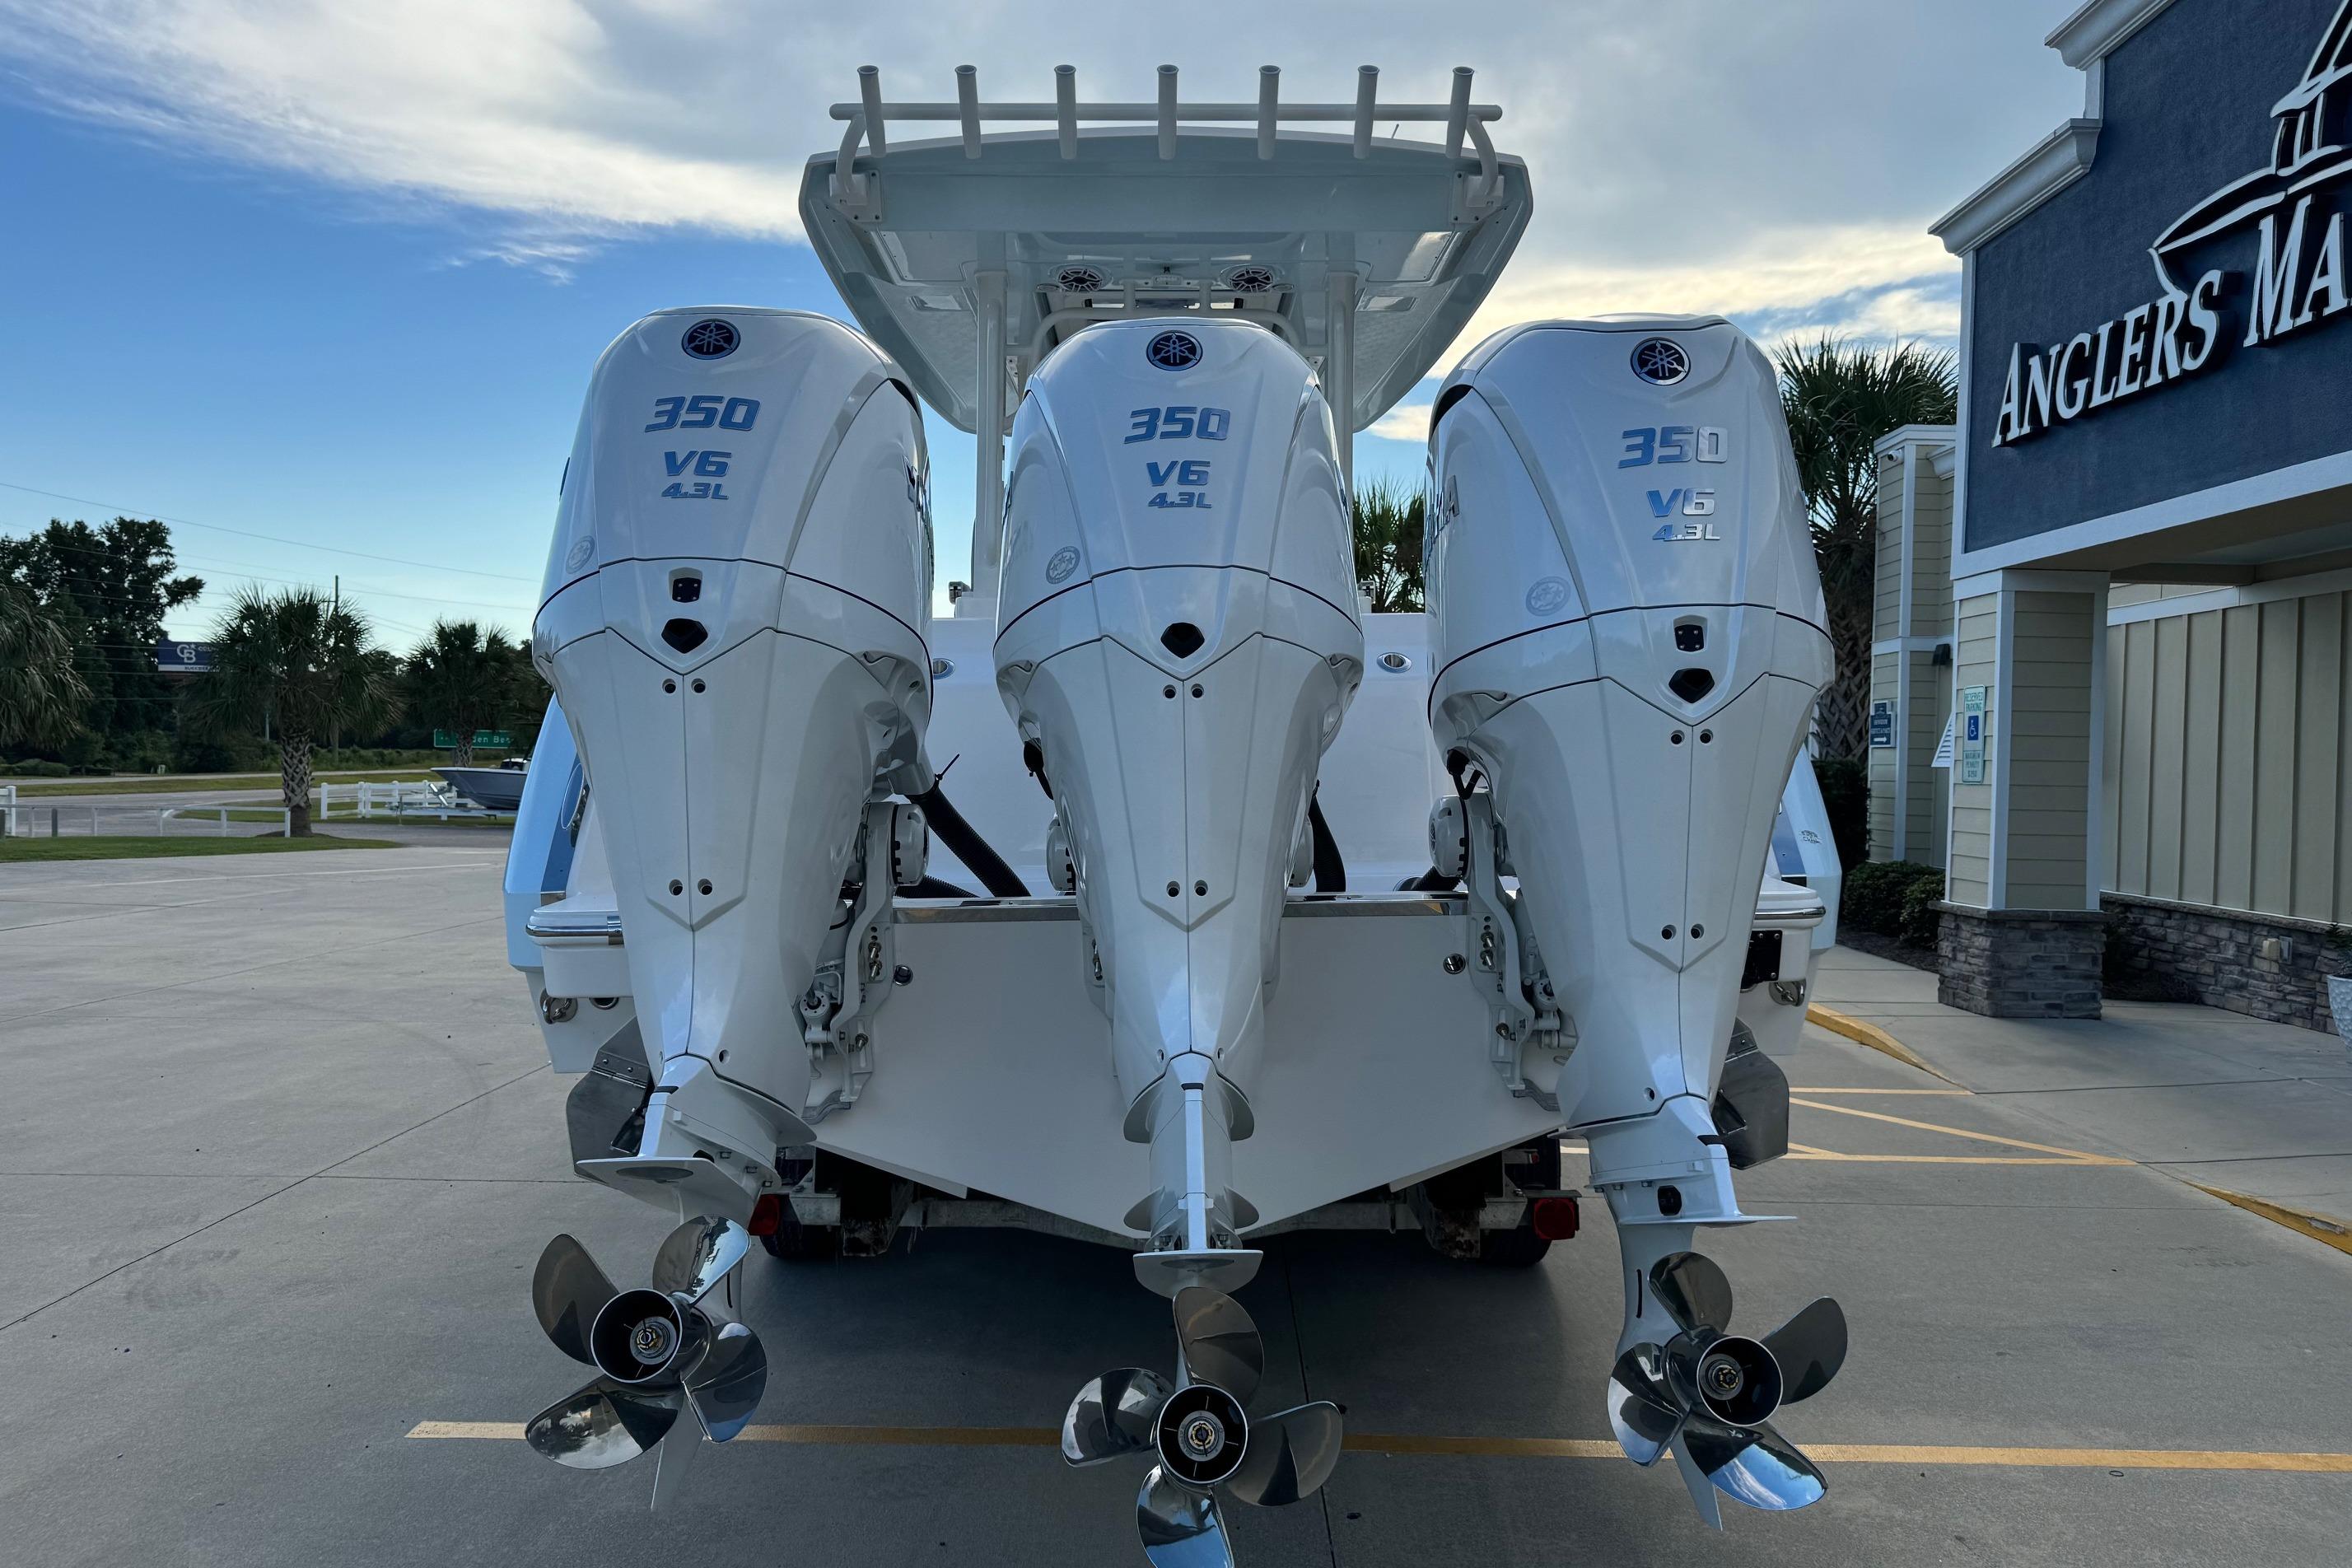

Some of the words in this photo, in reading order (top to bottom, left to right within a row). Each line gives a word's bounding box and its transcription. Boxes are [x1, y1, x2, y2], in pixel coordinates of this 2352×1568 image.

[1991, 269, 2222, 448] ANGLERS
[645, 395, 761, 433] 350
[1123, 406, 1230, 445] 350
[1617, 426, 1728, 469] 350
[664, 450, 732, 477] V6
[1146, 460, 1211, 487] V6
[661, 482, 729, 501] 4.3L
[1148, 492, 1212, 508] 4.3L
[1646, 488, 1715, 517] V6
[1653, 523, 1720, 541] 4.3L
